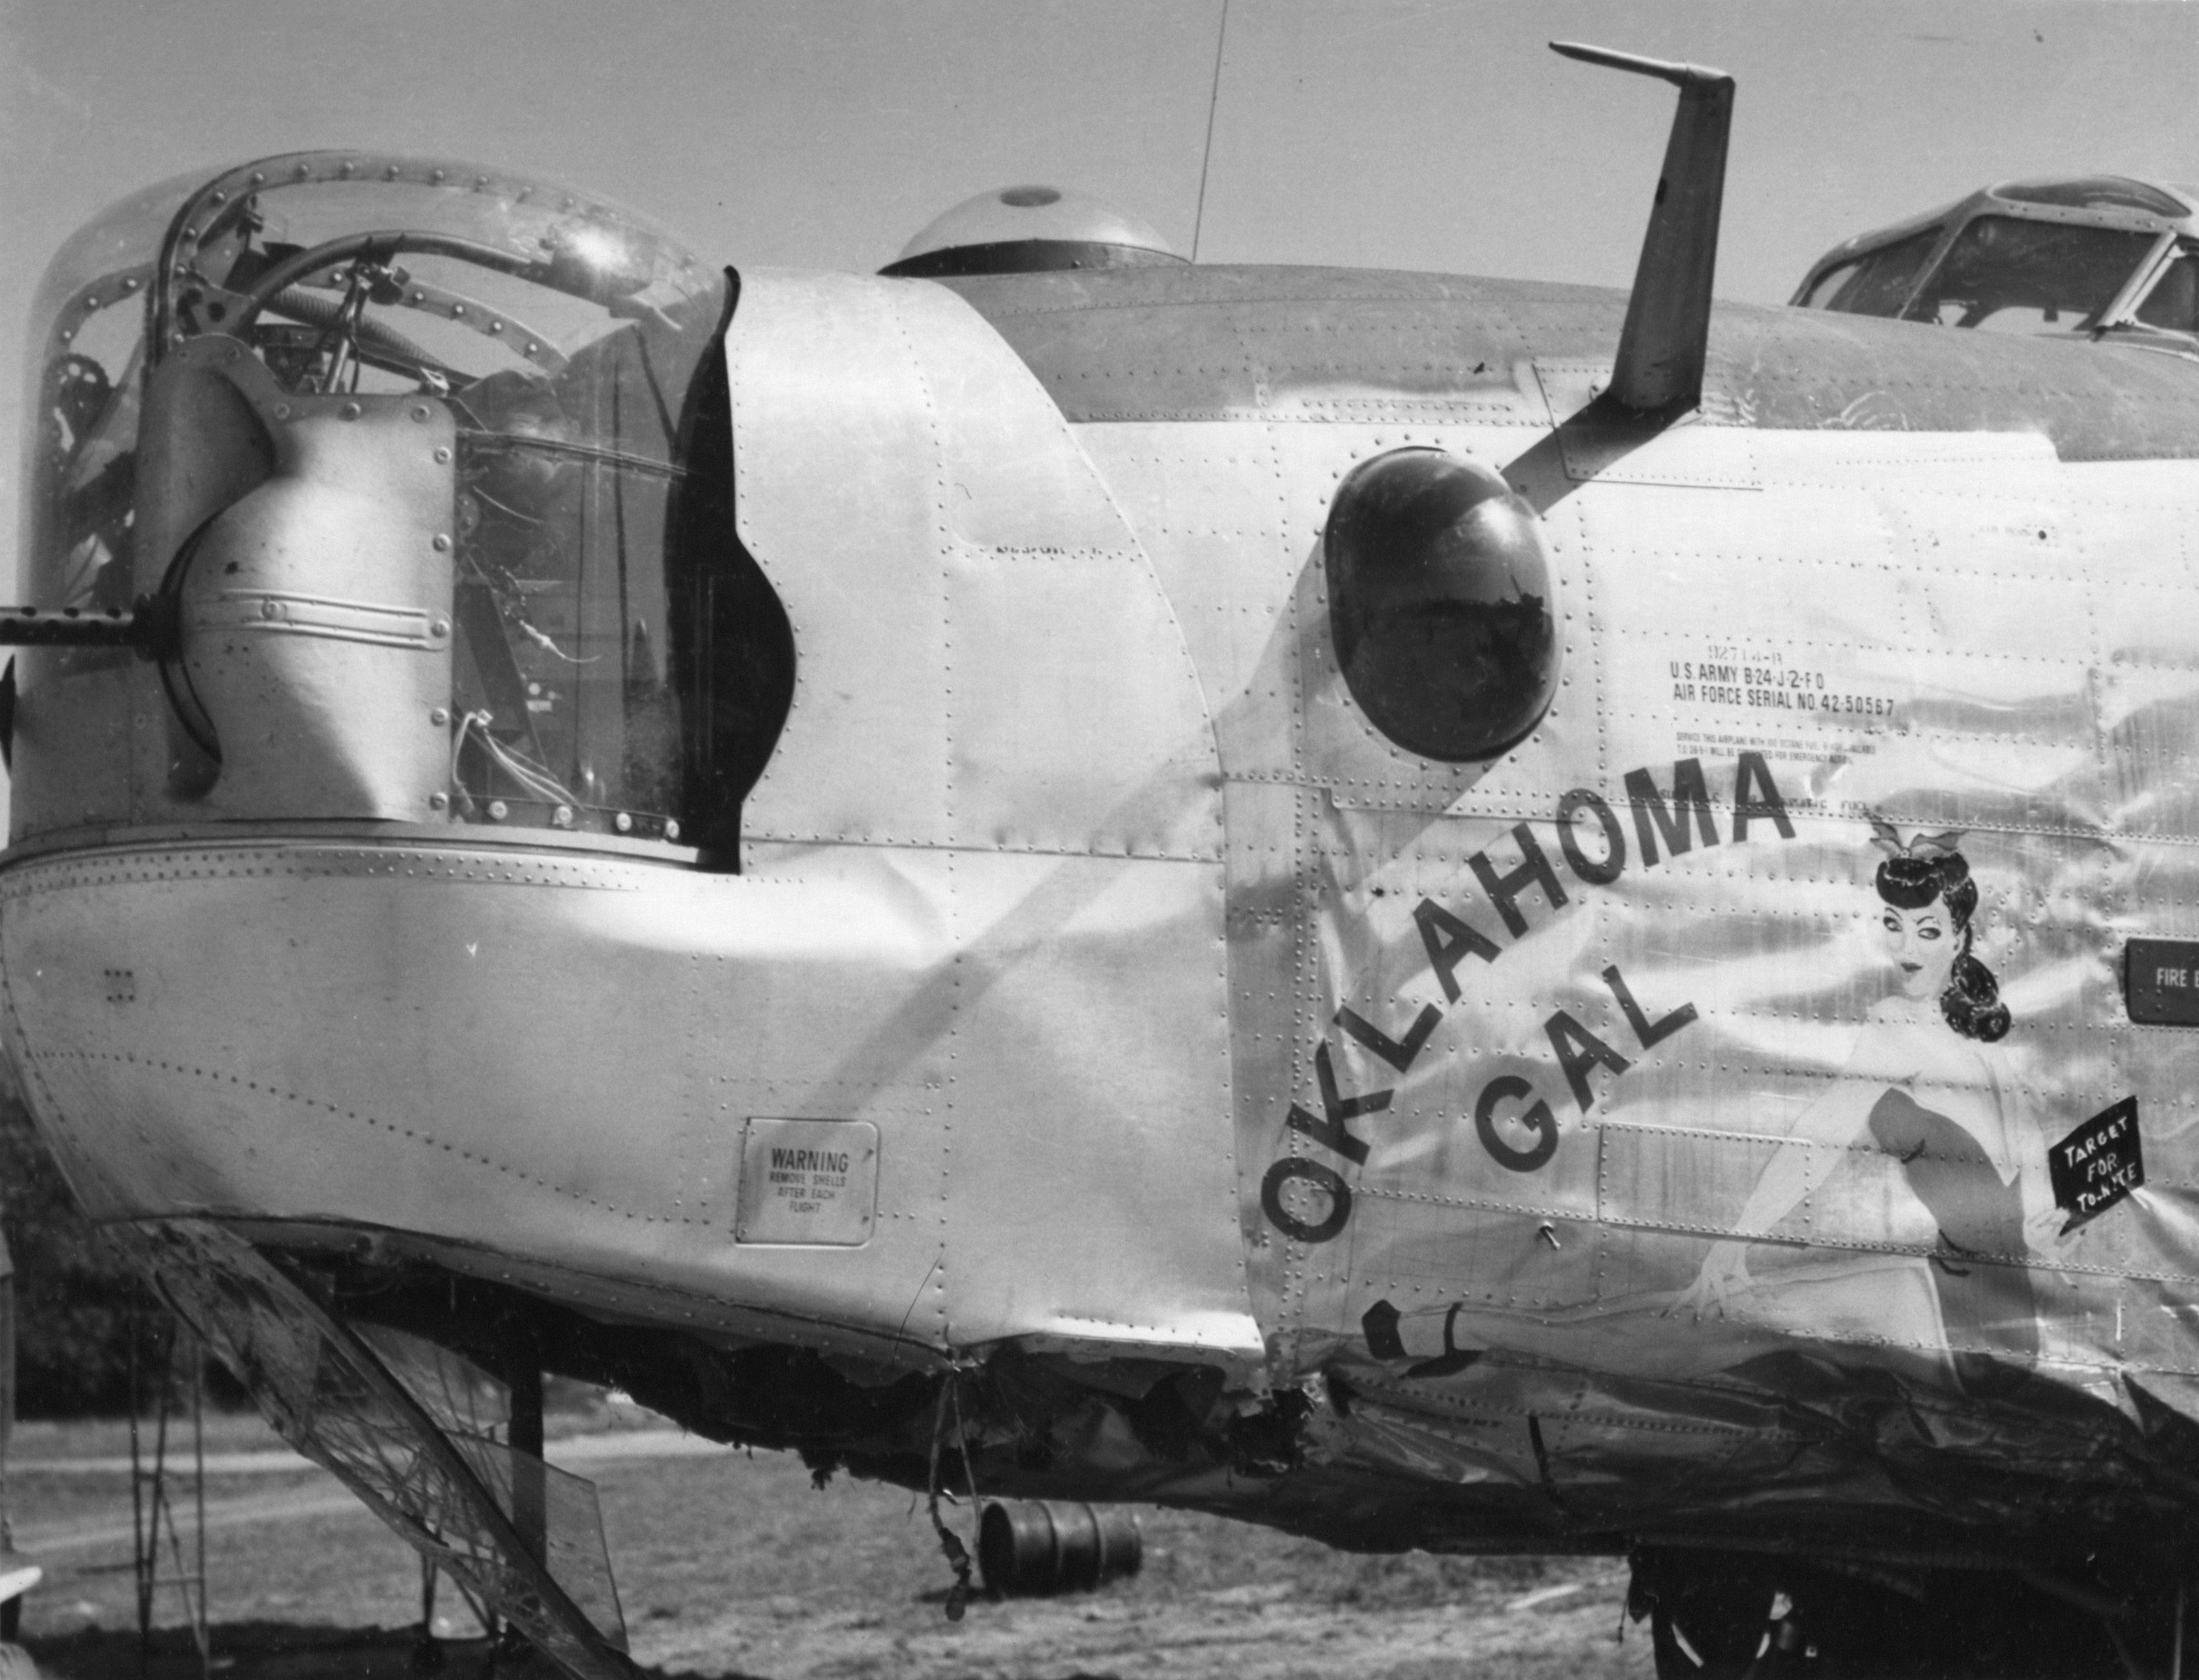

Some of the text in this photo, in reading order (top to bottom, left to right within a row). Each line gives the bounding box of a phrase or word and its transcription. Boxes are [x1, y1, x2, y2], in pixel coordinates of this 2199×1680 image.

[1699, 663, 1737, 683] ARMY
[1674, 683, 1696, 702] AIR
[1701, 685, 1742, 705] FORCE
[1747, 688, 1792, 709] SERIAL
[2157, 967, 2187, 987] FIRE
[1261, 751, 1795, 1244] OKLAHOMA
[1475, 964, 1699, 1173] GAL
[2064, 1116, 2128, 1169] TARGET
[771, 1148, 848, 1173] WARNING
[2088, 1152, 2118, 1183] FOR
[769, 1170, 847, 1187] REMOVE SHELLS
[778, 1186, 836, 1200] AFTER EACH
[789, 1200, 821, 1213] FLIGHT
